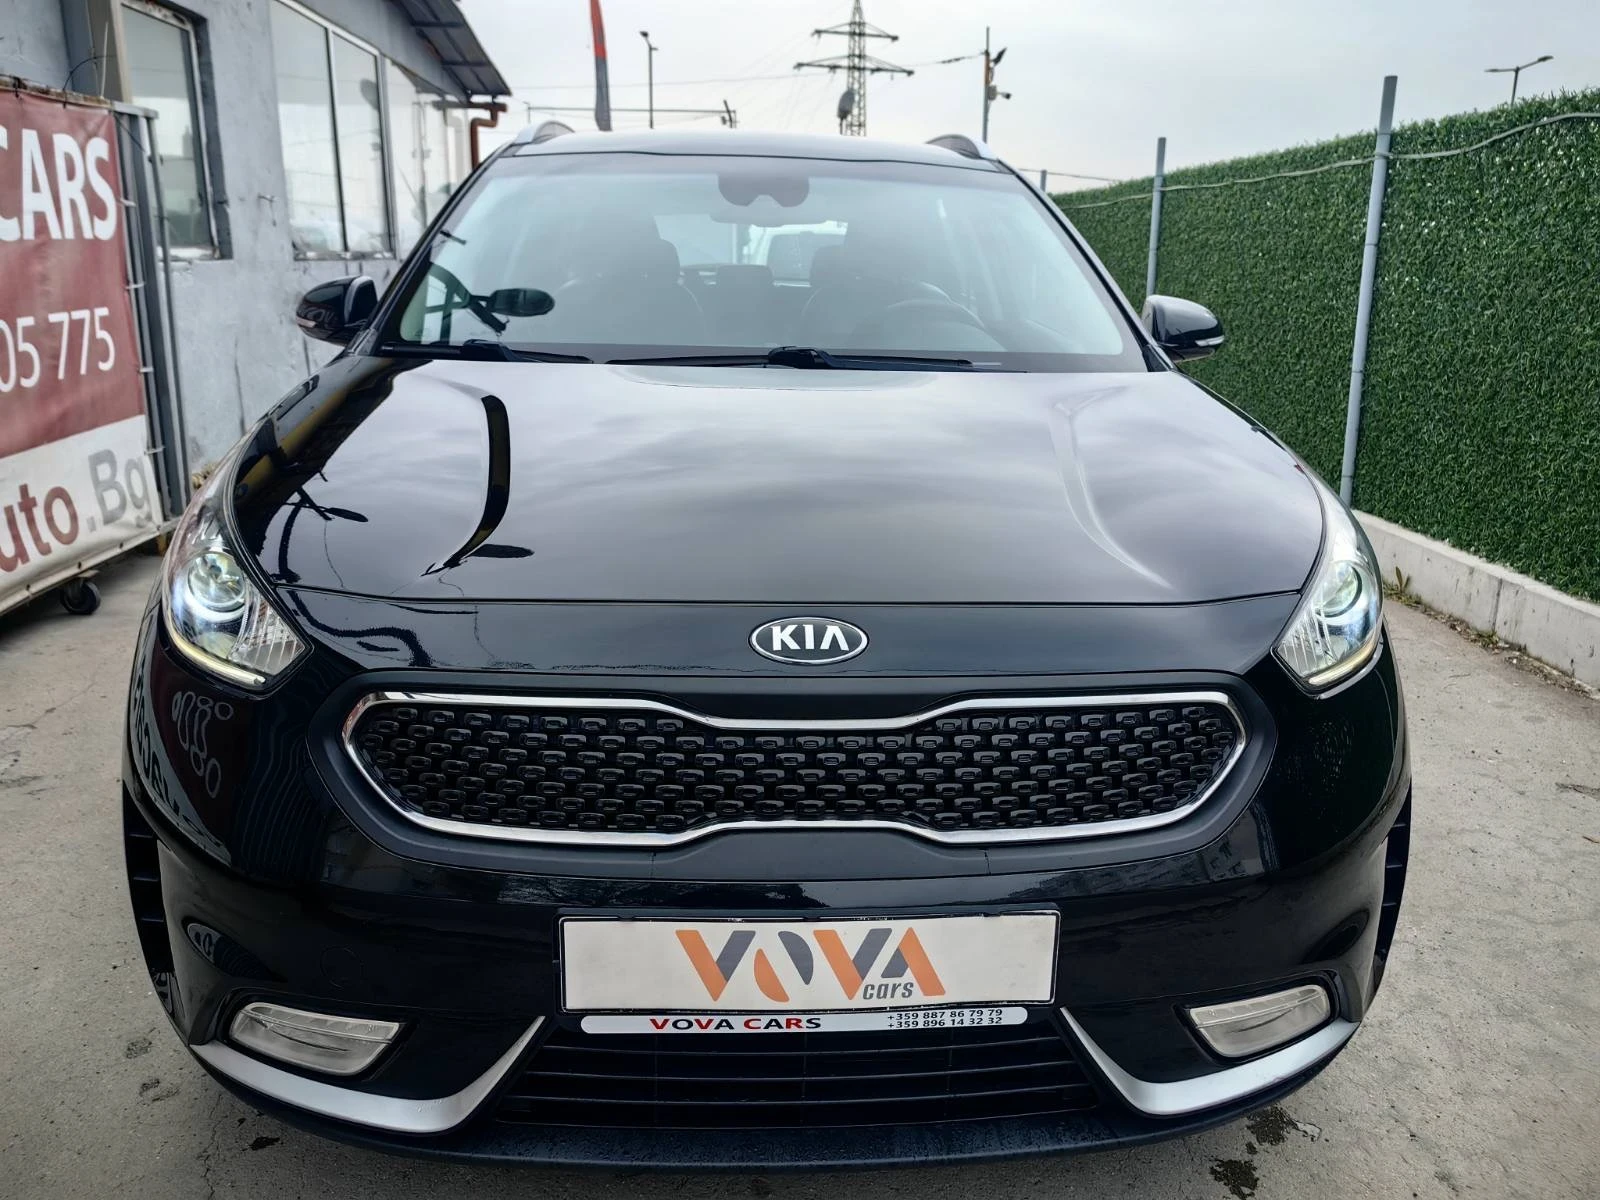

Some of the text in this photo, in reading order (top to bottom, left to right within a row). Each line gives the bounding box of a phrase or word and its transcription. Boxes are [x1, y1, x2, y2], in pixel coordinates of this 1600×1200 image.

[47, 306, 115, 380] 775
[771, 624, 850, 651] KIA
[675, 927, 946, 1002] VOVA
[862, 981, 914, 1000] cars
[650, 1017, 822, 1030] VOVA CARS
[888, 1008, 1003, 1021] +359 887 86 79 79
[888, 1016, 1003, 1029] +359 896 14 32 32
